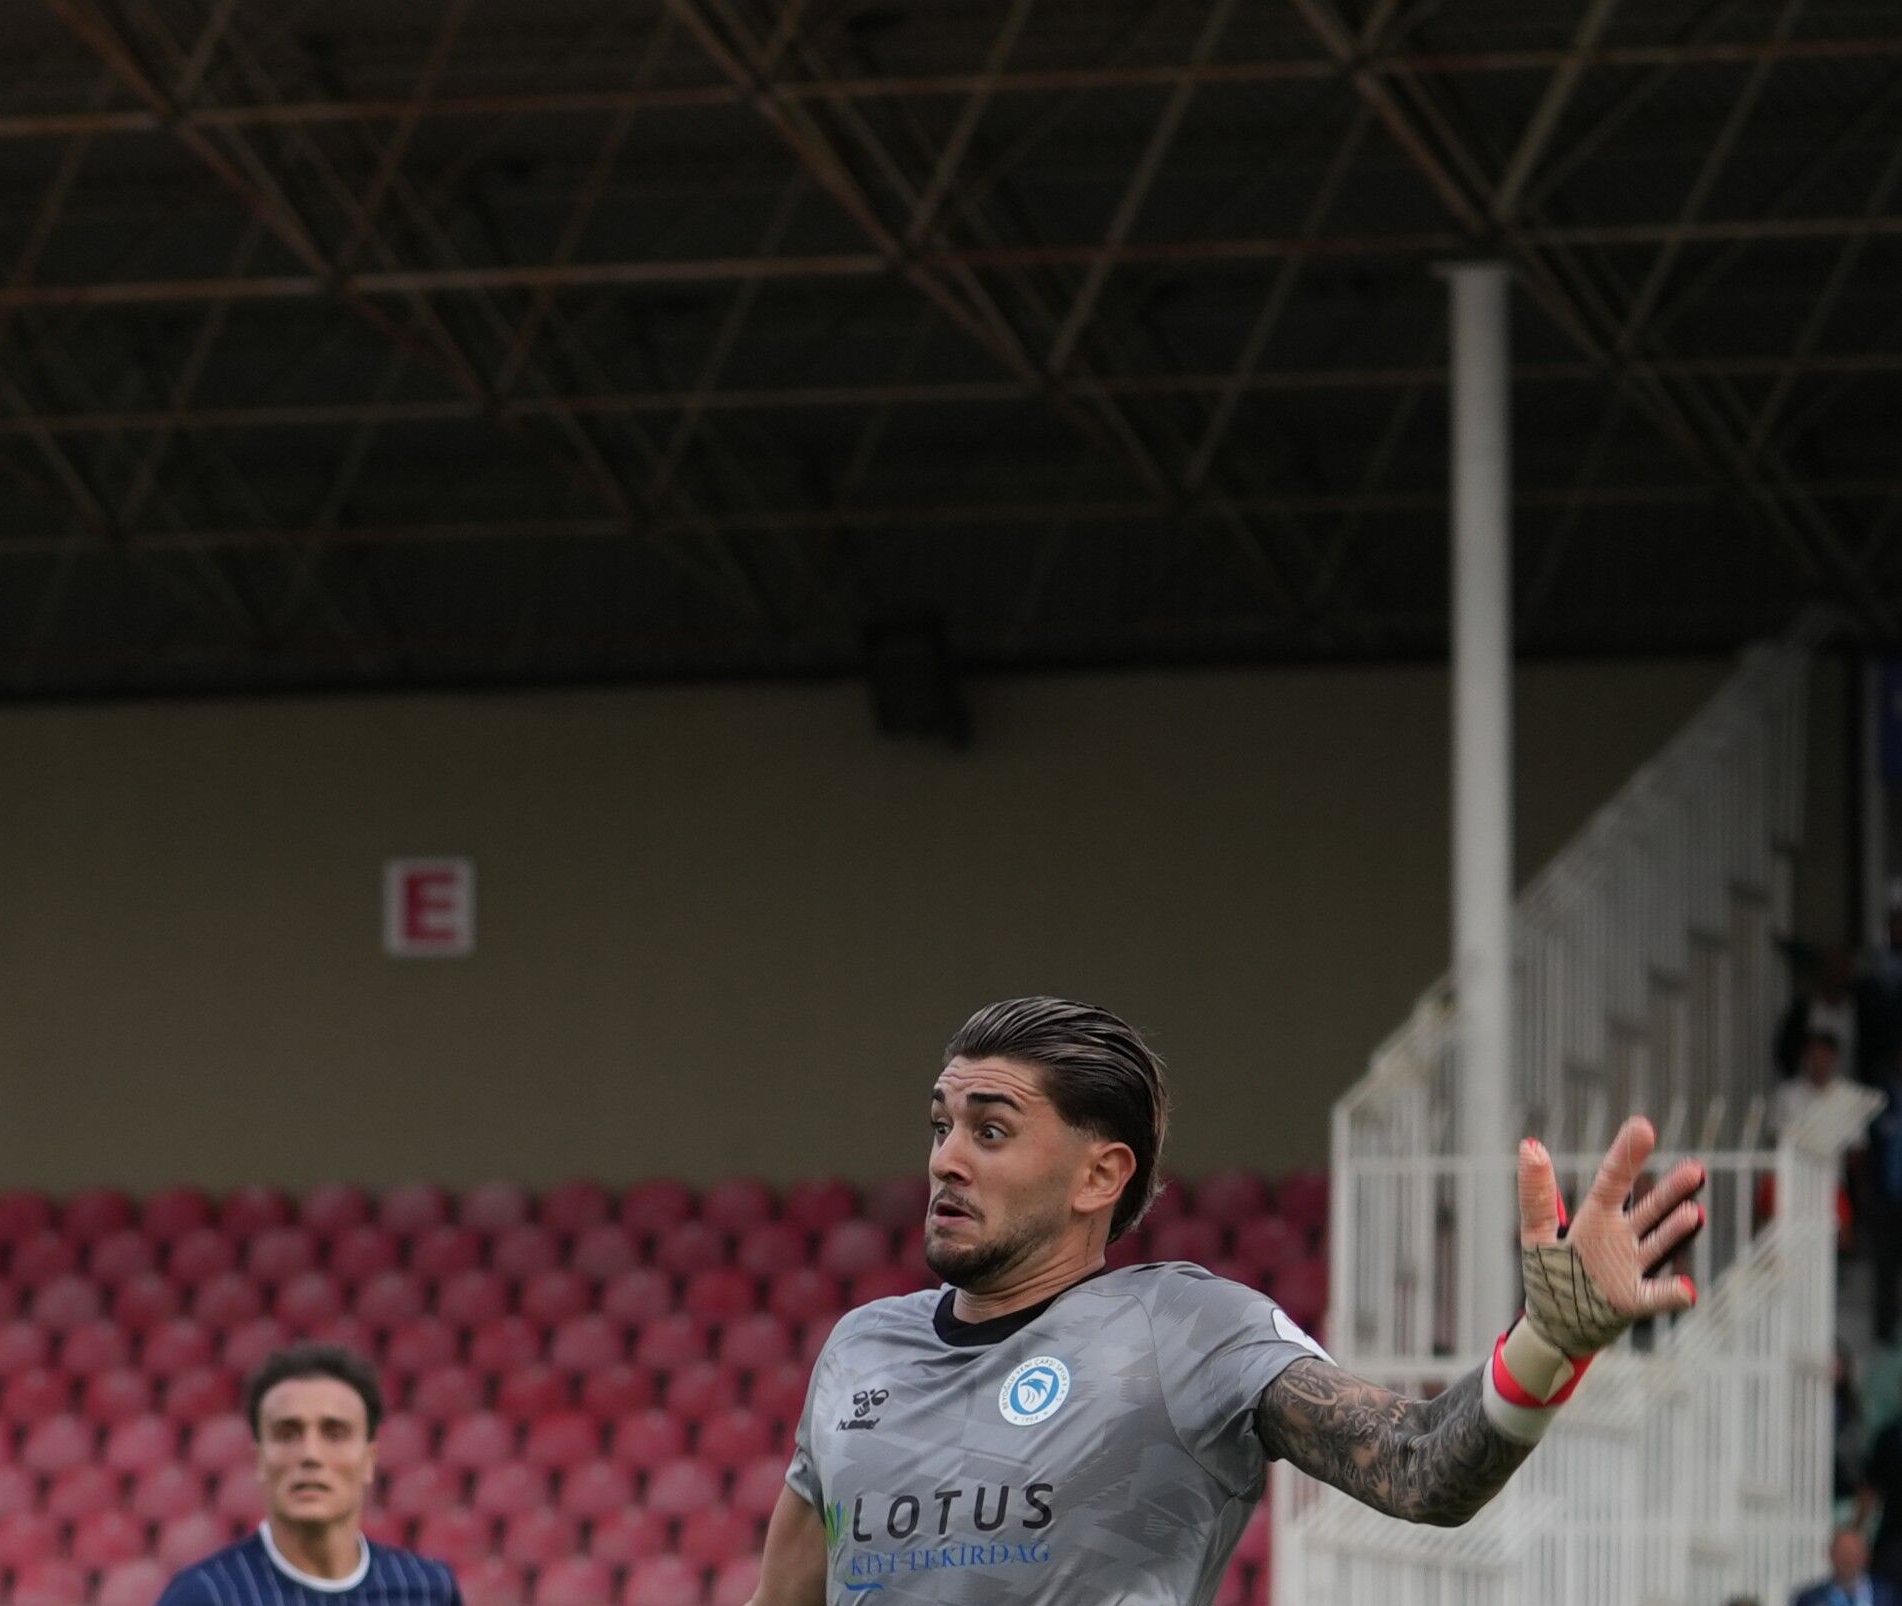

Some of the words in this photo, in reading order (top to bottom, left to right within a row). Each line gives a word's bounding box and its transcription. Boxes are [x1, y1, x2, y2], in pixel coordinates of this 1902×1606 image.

[405, 872, 455, 941] E
[852, 1483, 1054, 1543] LOTUS
[909, 1536, 1052, 1572] TEKİRDAĞ
